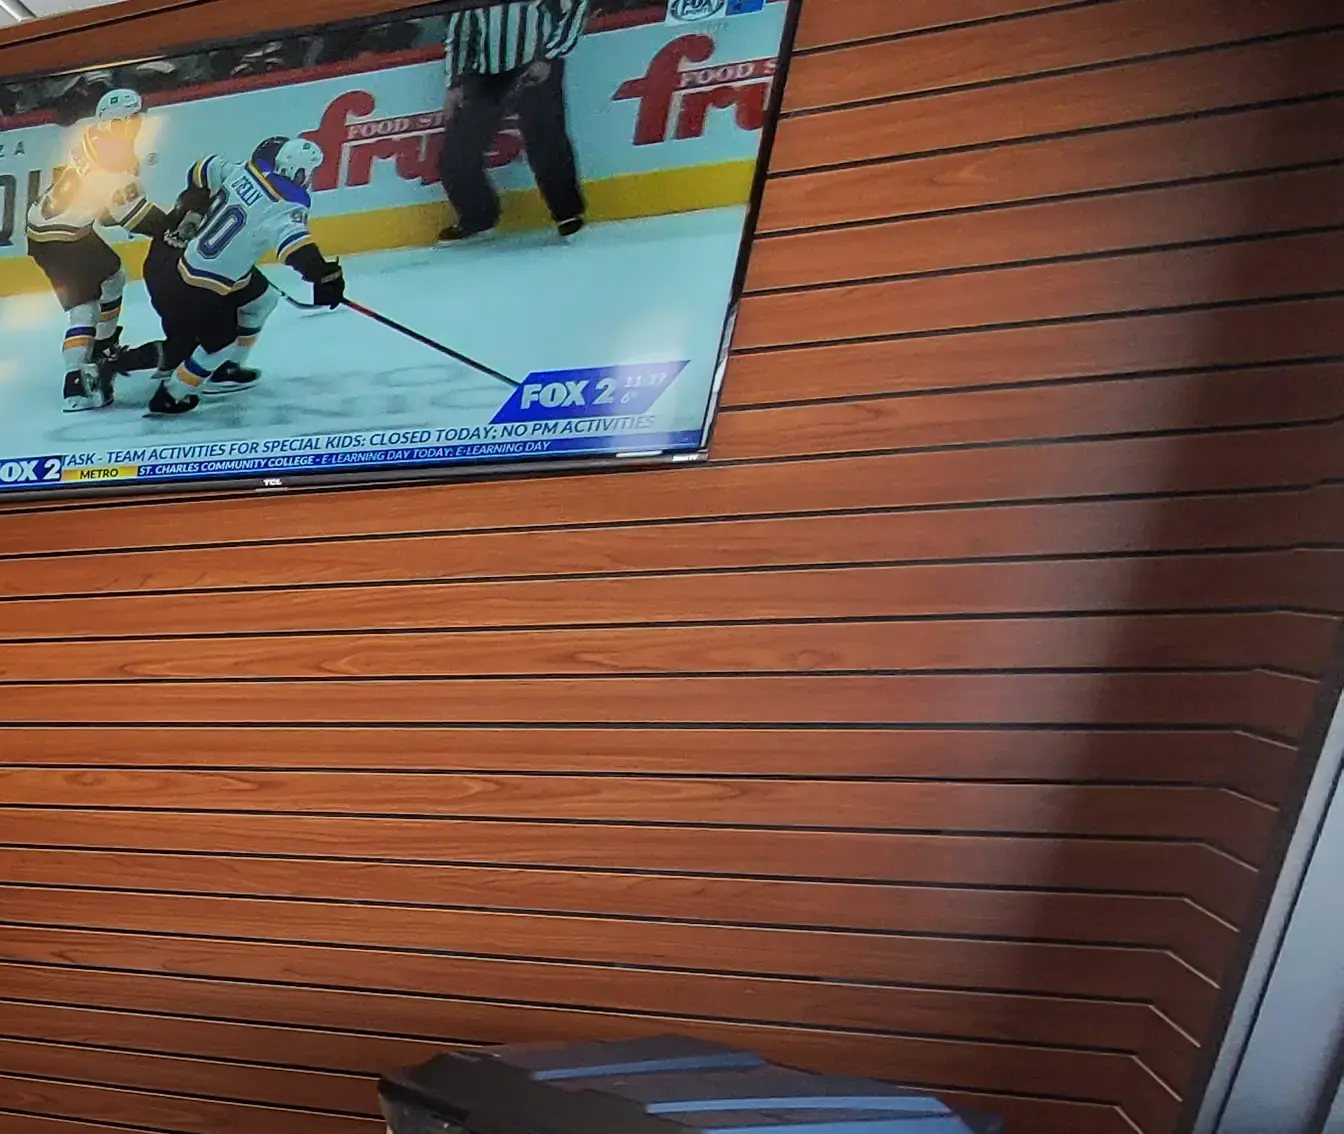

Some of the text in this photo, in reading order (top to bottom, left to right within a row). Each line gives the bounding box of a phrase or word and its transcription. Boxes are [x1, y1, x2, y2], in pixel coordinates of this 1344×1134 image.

[349, 117, 409, 138] FOOD
[520, 377, 617, 410] FOX 2
[62, 453, 95, 467] TASK
[106, 450, 146, 464] TEAM
[146, 445, 226, 462] ACTIVITIES
[230, 442, 259, 456] FOR
[261, 438, 322, 454] SPECIAL
[324, 434, 366, 449] KIDS:
[369, 430, 431, 447] CLOSED
[500, 422, 529, 438] NO
[530, 420, 558, 436] PM
[558, 414, 656, 434] ACTIVITIES
[43, 458, 61, 480] 2
[137, 464, 155, 477] ST.
[155, 461, 200, 475] CHARLES
[200, 458, 268, 473] COMMUNITY
[268, 454, 315, 468] COLLEGE
[386, 449, 411, 461] DAY
[524, 441, 551, 452] DAY
[78, 467, 120, 480] METRO
[262, 477, 282, 487] TCL
